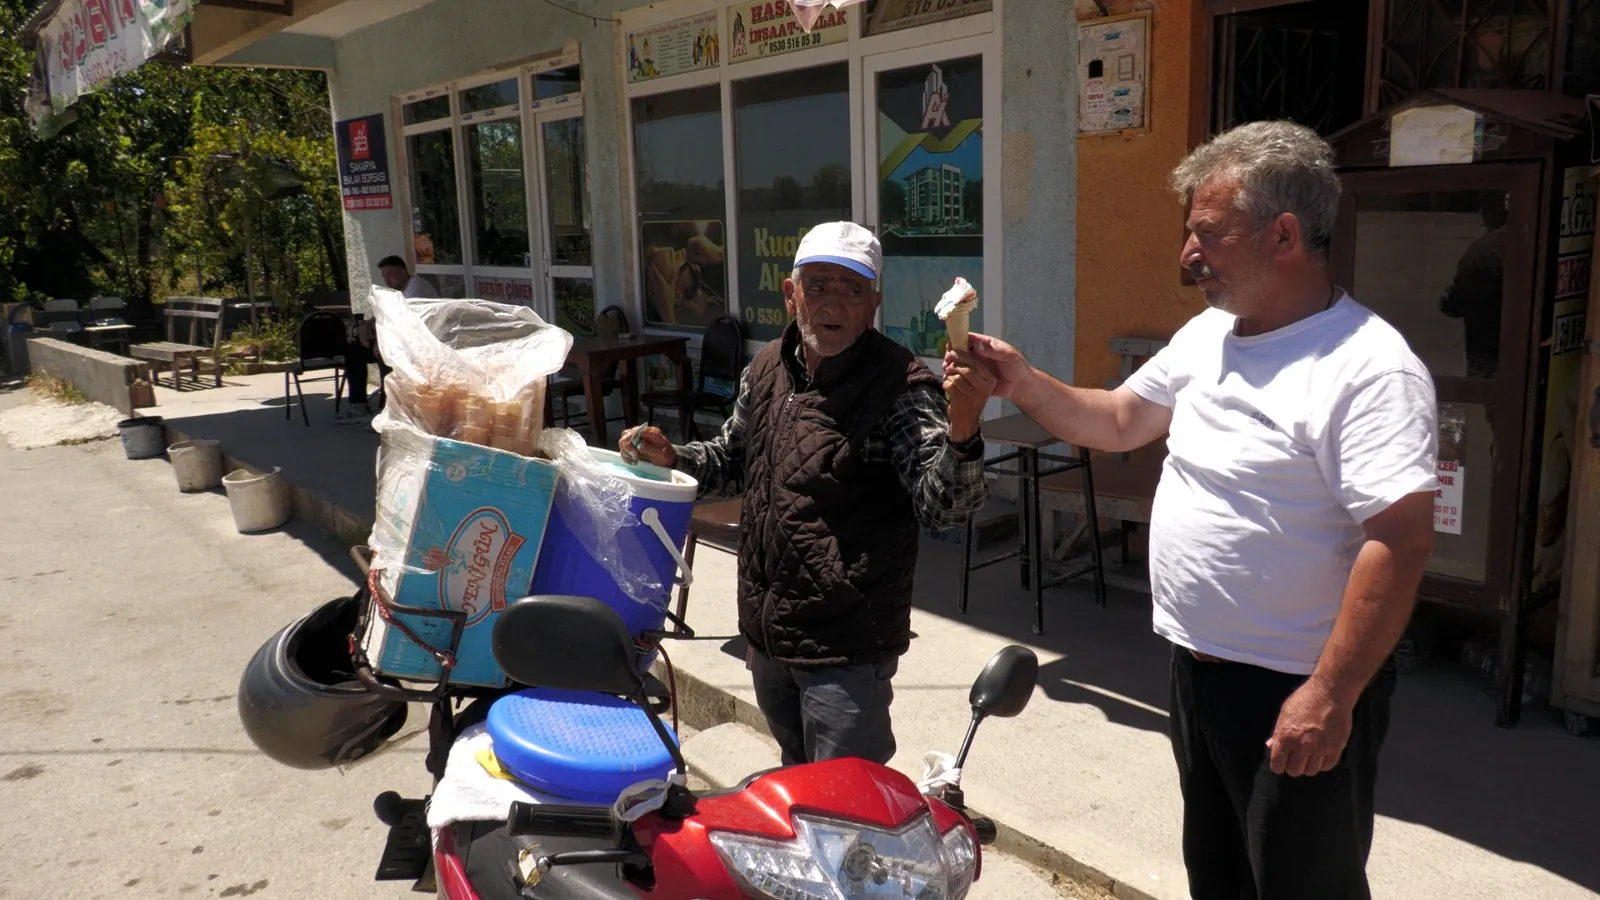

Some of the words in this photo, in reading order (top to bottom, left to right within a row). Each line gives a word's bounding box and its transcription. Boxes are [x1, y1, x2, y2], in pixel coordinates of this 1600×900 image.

[769, 39, 786, 53] 0530
[787, 37, 800, 49] 516
[801, 34, 810, 46] 05
[812, 32, 821, 44] 30
[349, 161, 376, 172] SAKARYA
[745, 306, 754, 323] 0
[756, 307, 783, 325] 530
